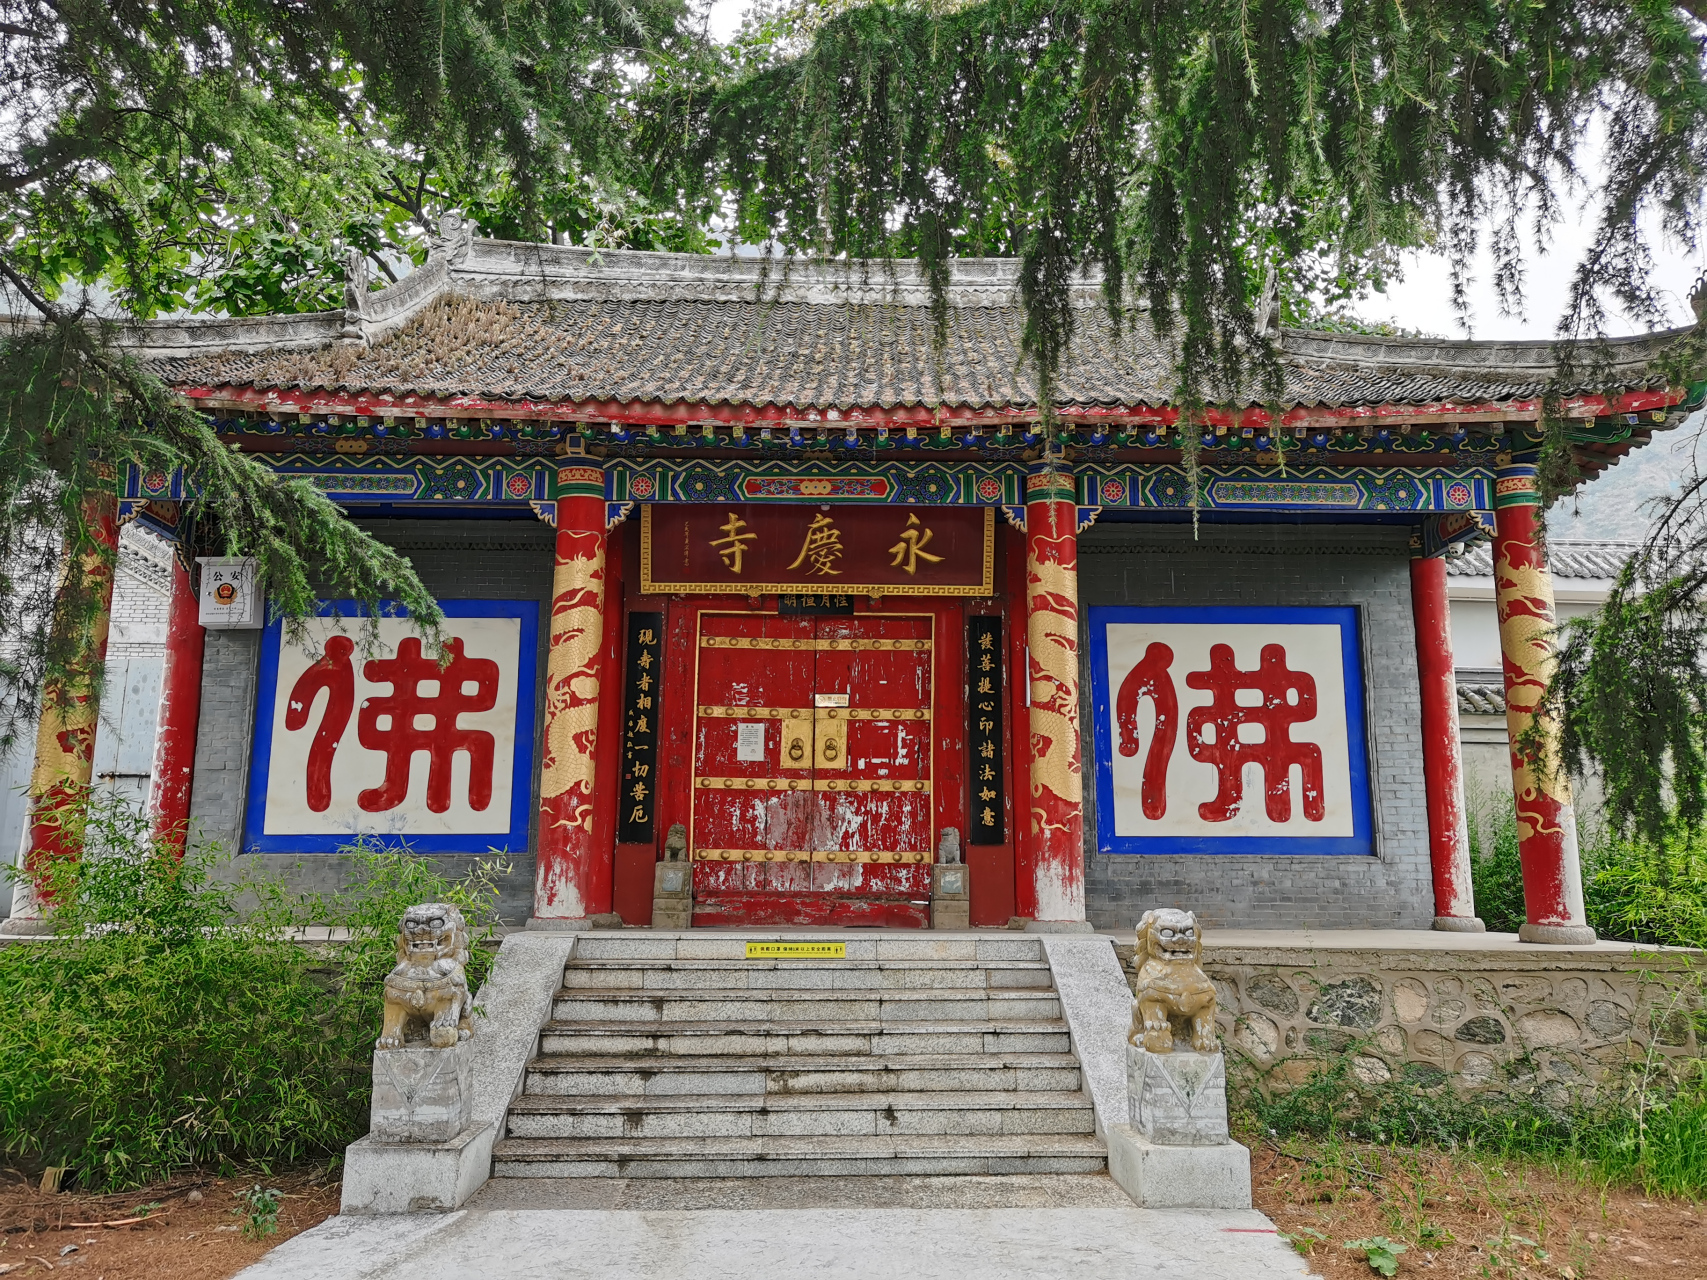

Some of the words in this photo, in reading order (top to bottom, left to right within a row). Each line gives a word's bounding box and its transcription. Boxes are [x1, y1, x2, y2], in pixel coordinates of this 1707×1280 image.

[213, 571, 241, 581] 公安
[285, 635, 500, 814] 佛
[1116, 641, 1325, 823] 佛
